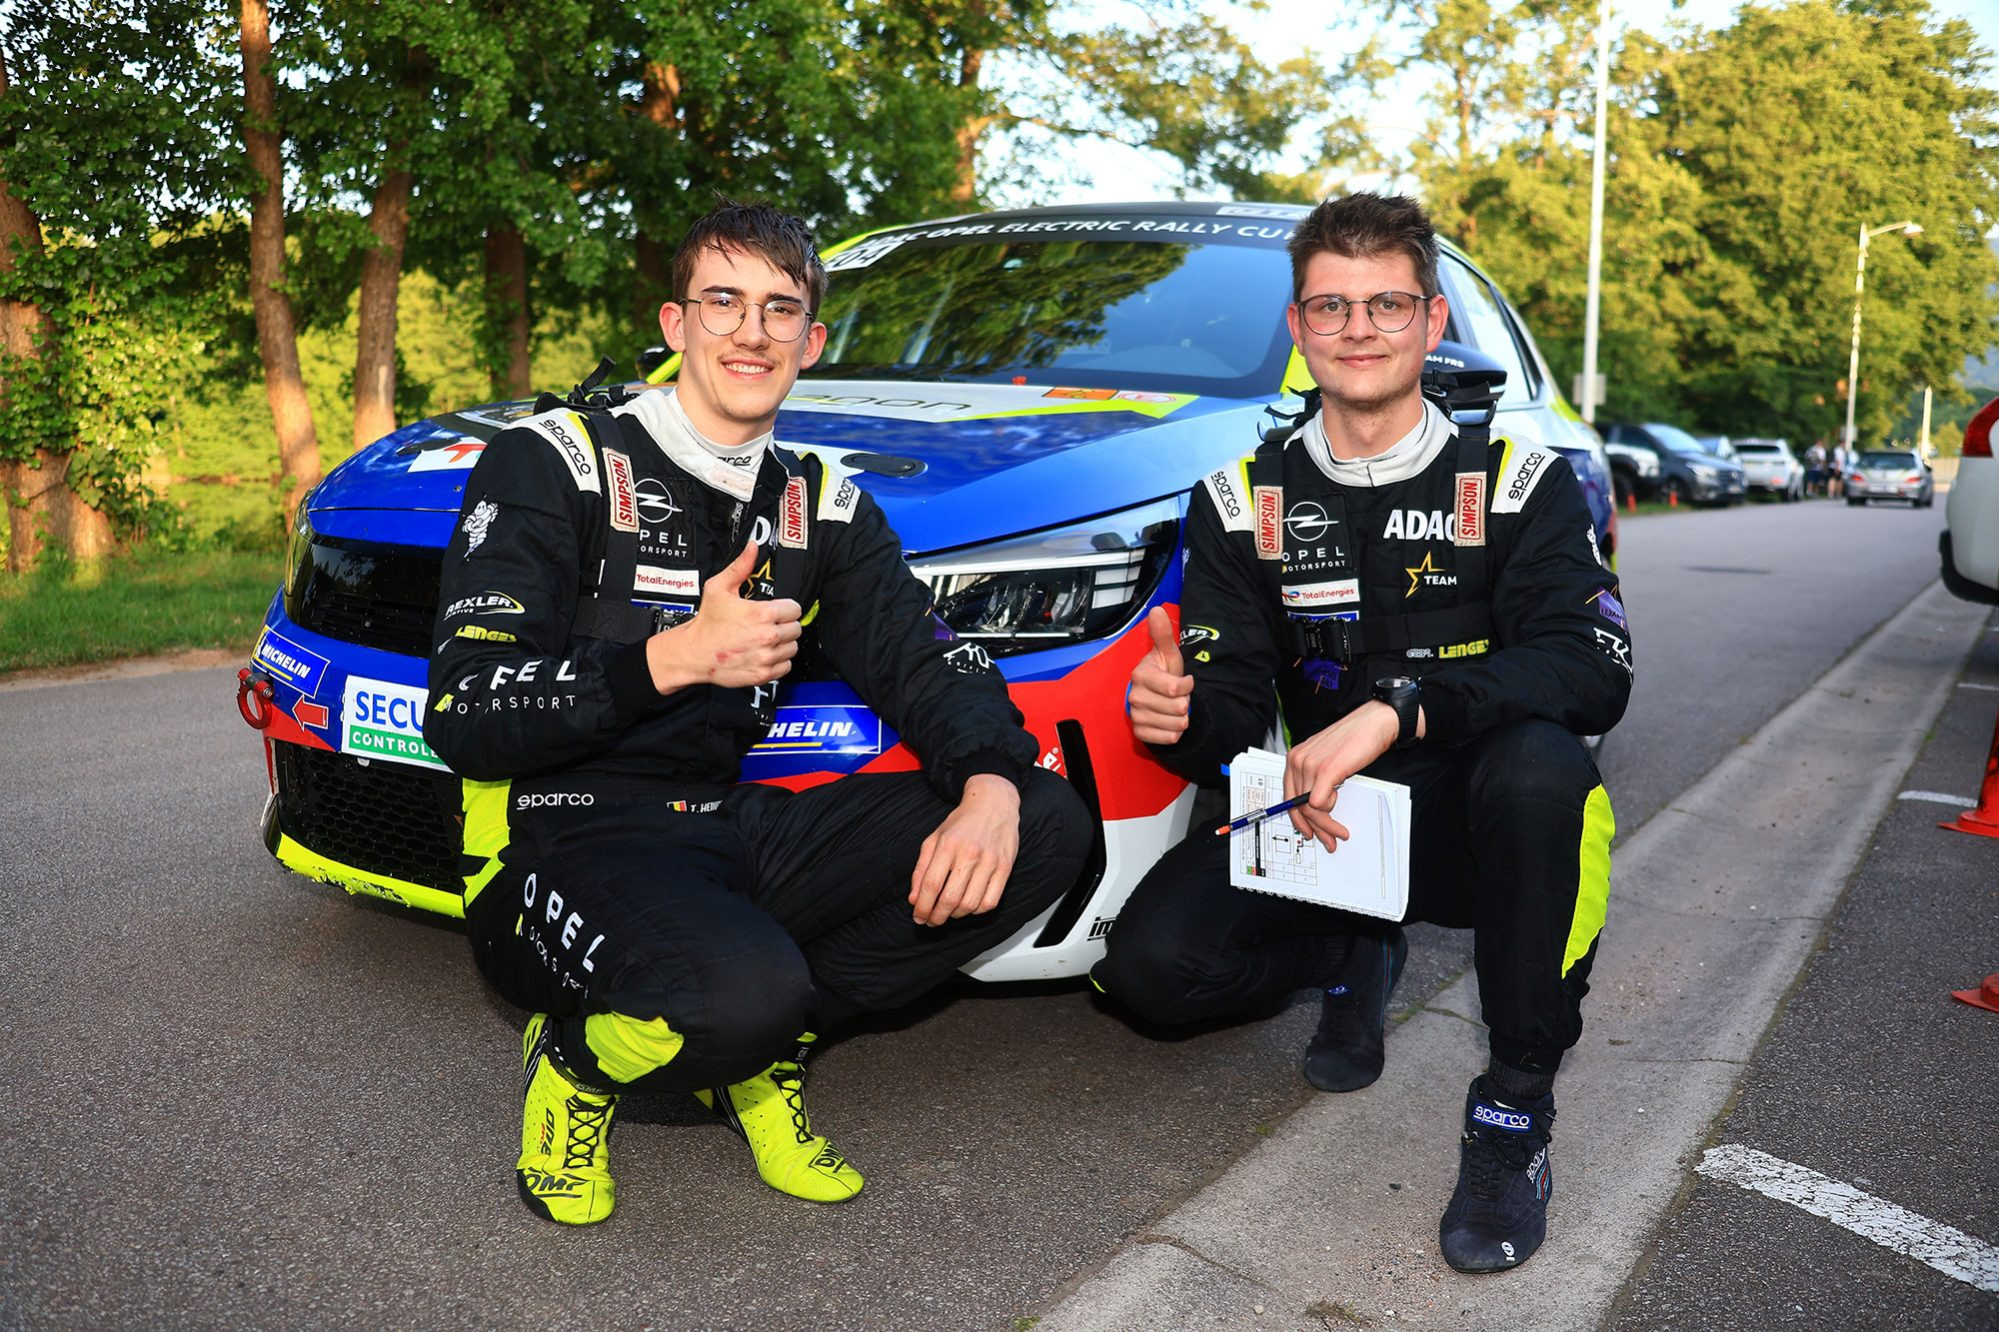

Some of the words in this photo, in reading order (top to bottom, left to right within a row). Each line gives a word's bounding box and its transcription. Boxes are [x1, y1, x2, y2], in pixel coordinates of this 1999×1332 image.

[927, 224, 995, 238] OPEL
[997, 220, 1131, 233] ELECTRIC
[1132, 220, 1233, 234] RALLY
[1425, 354, 1443, 363] AM
[539, 420, 591, 476] sparco
[1508, 452, 1546, 501] sparco
[612, 459, 633, 522] SIMPSON
[1211, 471, 1241, 519] sparco
[787, 481, 802, 540] SIMPSON
[1462, 482, 1478, 537] SIMPSON
[1262, 494, 1275, 550] SIMPSON
[639, 529, 688, 546] PEL
[640, 546, 688, 558] ORSPORT
[1282, 546, 1345, 562] OPEL
[1282, 560, 1346, 573] OTORSPORT
[636, 574, 695, 589] TotalEnergies
[1423, 575, 1458, 585] TEAM
[1302, 588, 1355, 600] TotalEnergies
[262, 644, 311, 679] MICHELIN
[767, 721, 852, 738] HELIN
[517, 793, 594, 810] sparco
[524, 873, 605, 973] OPEL
[1473, 1105, 1530, 1129] sparco
